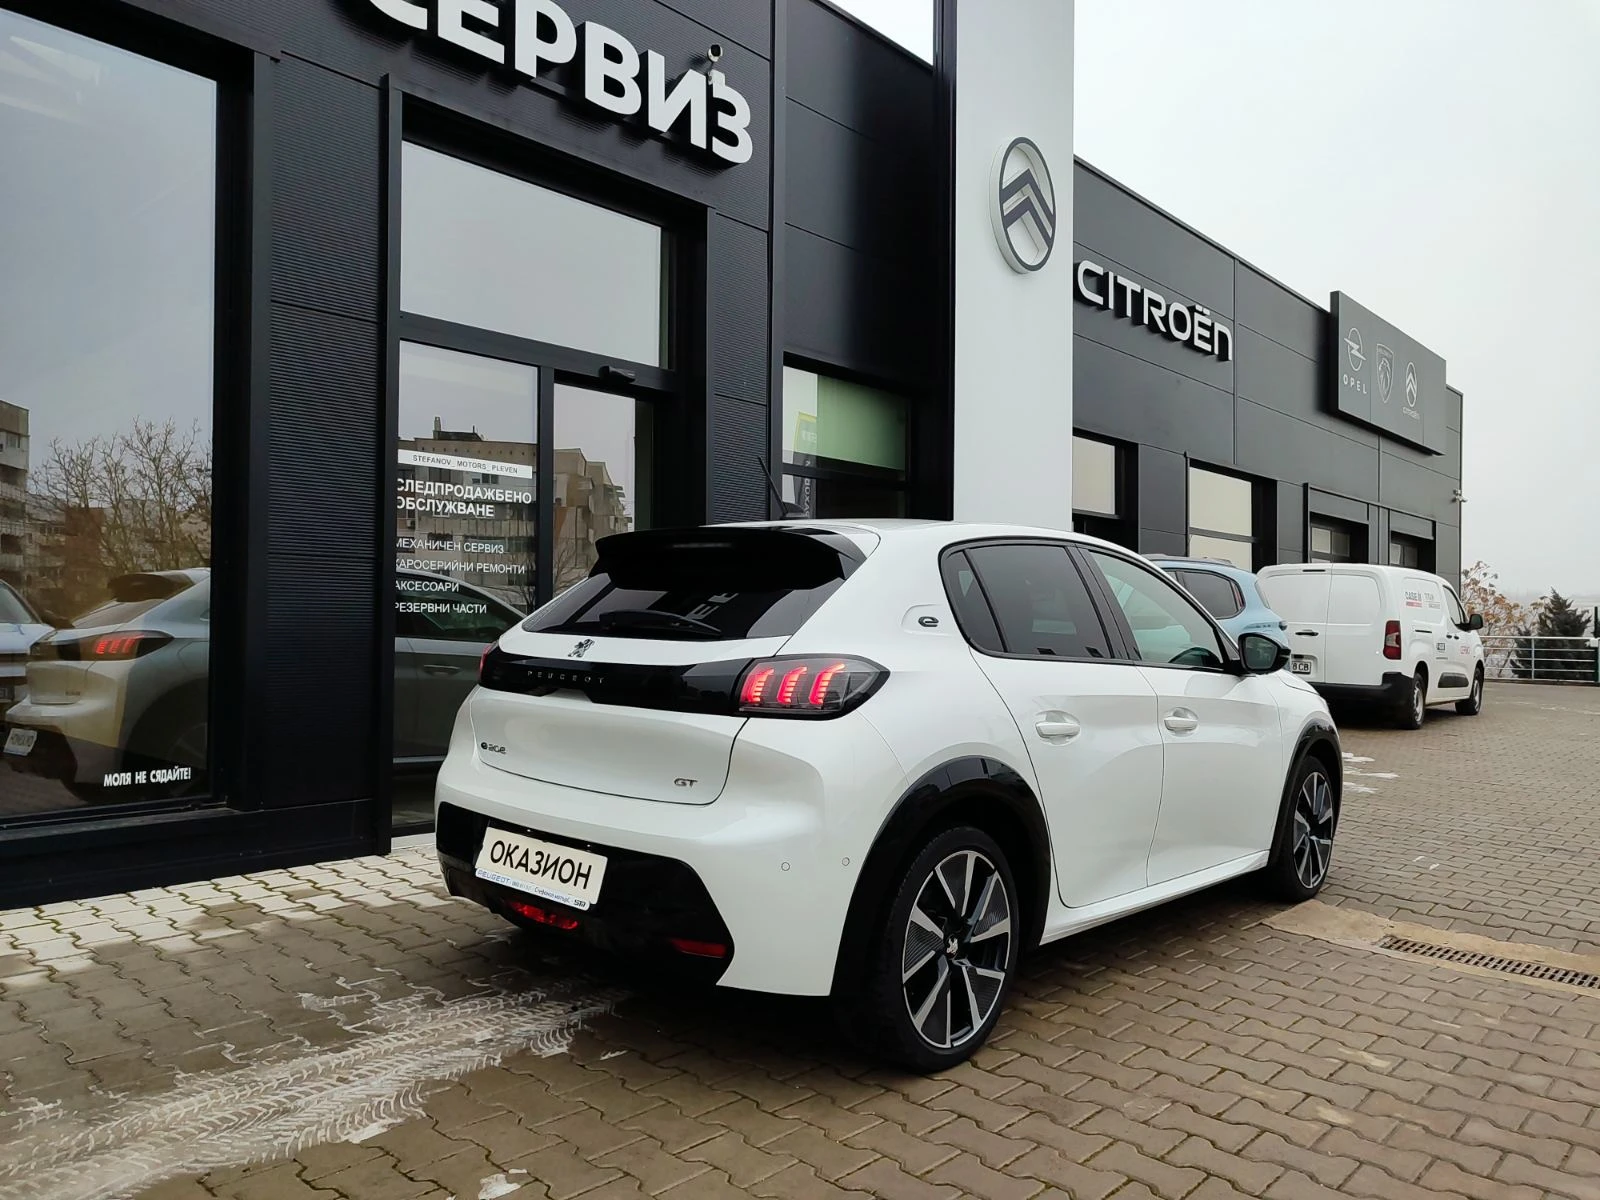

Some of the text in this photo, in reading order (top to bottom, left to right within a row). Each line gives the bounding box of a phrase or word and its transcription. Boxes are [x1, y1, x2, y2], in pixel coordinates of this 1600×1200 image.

[1077, 260, 1233, 361] CITROËN
[1343, 373, 1368, 394] OPEL
[492, 464, 518, 474] PLEVEN
[463, 542, 504, 554] СЕРВИЗ
[476, 562, 525, 574] РЕМОНТИ
[452, 604, 487, 614] ЧАСТИ
[527, 670, 604, 684] PEUGEOT
[104, 765, 191, 787] МОЛЯ НЕ СЯДАЙТЕ!
[674, 777, 698, 788] GT
[490, 840, 593, 890] ОКАЗИОН
